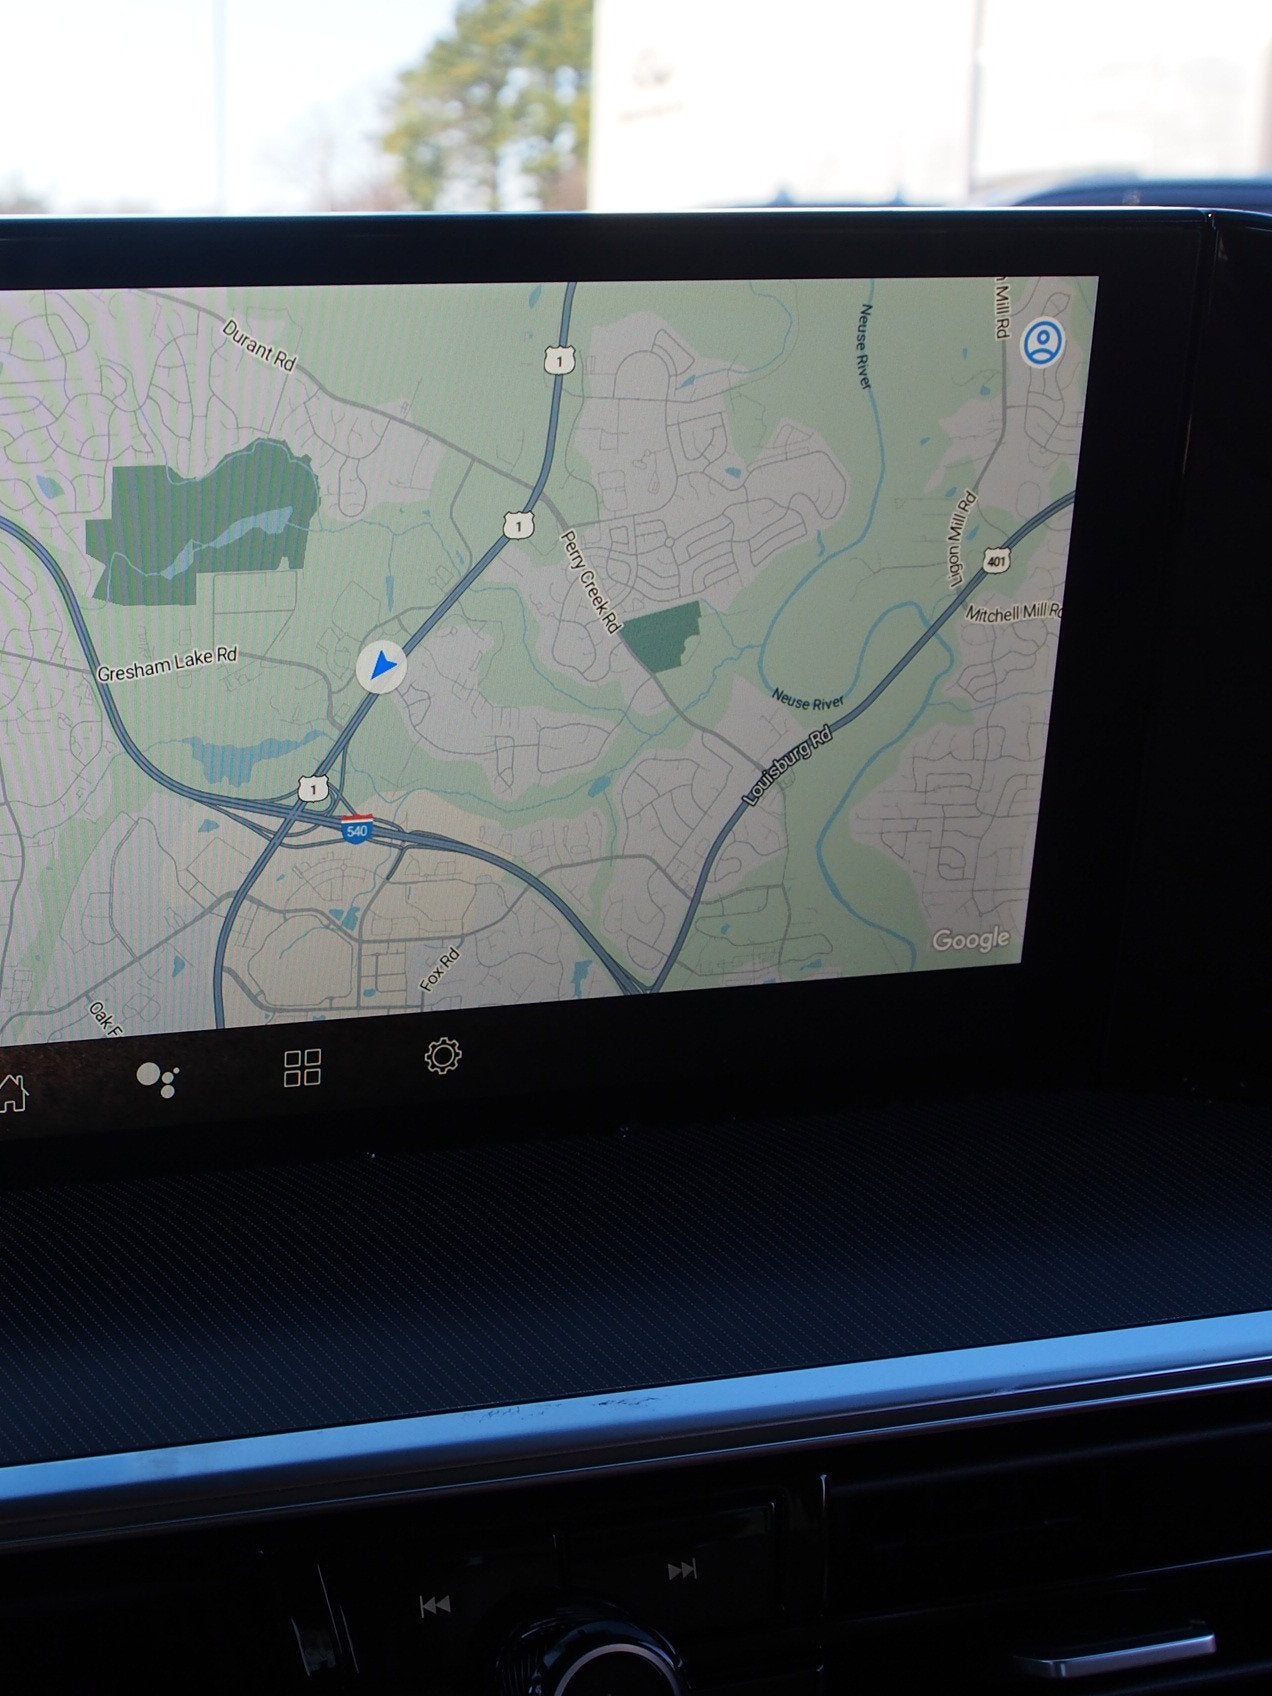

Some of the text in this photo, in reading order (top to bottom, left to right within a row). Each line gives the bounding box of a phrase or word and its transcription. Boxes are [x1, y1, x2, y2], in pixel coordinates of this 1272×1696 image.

[996, 286, 1010, 315] Mill
[996, 318, 1010, 339] Rd
[222, 319, 297, 372] Durant Rd
[856, 303, 873, 390] Neuse River
[947, 490, 978, 588] Ligon Mill Rd
[987, 556, 1006, 567] 401
[561, 530, 623, 635] Perry Creek Rd
[965, 604, 1020, 623] Mitchell
[1023, 602, 1048, 619] Mill
[97, 646, 238, 682] Gresham Lake Rd
[771, 687, 845, 711] Neuse River
[741, 723, 834, 807] Louisburg Rd
[346, 825, 368, 837] 540
[932, 924, 1011, 954] Google
[419, 946, 460, 992] Fox Rd
[89, 1001, 113, 1030] Oak
